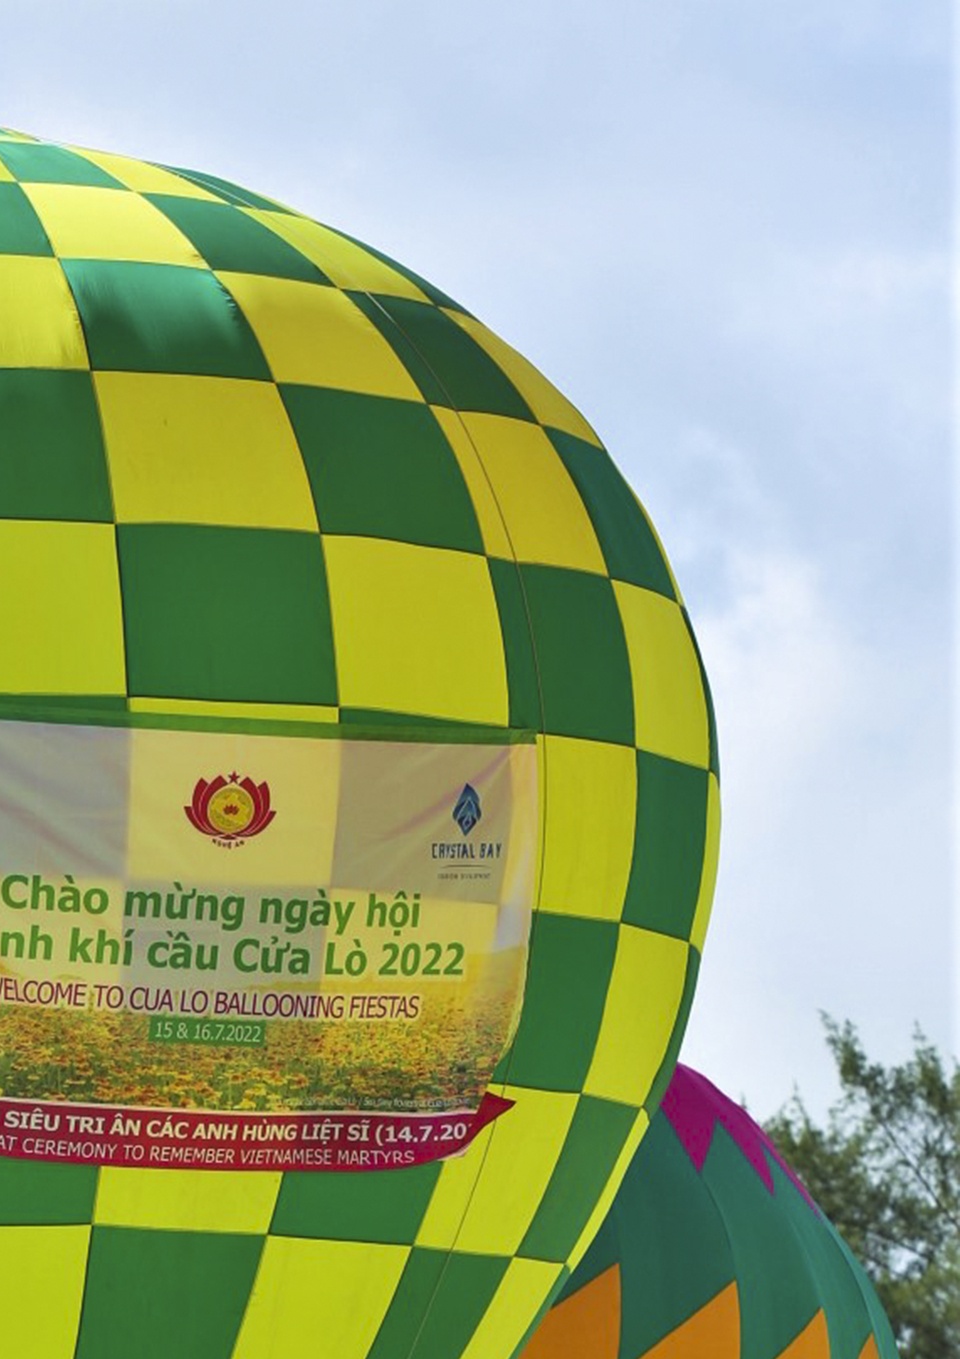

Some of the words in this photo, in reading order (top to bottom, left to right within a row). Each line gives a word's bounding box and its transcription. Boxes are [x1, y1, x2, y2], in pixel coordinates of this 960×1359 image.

[431, 842, 475, 860] CRYSTAL
[479, 842, 502, 860] BAY
[0, 874, 110, 915] Chào
[123, 881, 246, 932] mừng
[258, 888, 356, 936] ngày
[365, 890, 422, 937] hội
[68, 926, 136, 967] khí
[146, 931, 220, 971] cầu
[232, 936, 311, 975] Cửa
[324, 939, 368, 977] Lò
[377, 942, 466, 977] 2022
[93, 984, 124, 1009] TO
[128, 986, 174, 1012] CUA
[179, 989, 209, 1014] LO
[213, 991, 345, 1019] BALLOONING
[348, 994, 420, 1019] FIESTAS
[154, 1021, 174, 1039] 15
[176, 1022, 189, 1039] &
[193, 1023, 261, 1043] 16.7.2022
[3, 1108, 61, 1131] SIÊU
[65, 1114, 106, 1136] TRI
[109, 1112, 141, 1137] ÂN
[145, 1114, 190, 1140] CÁC
[192, 1122, 238, 1142] ANH
[242, 1118, 298, 1142] HÙNG
[300, 1118, 345, 1146] LIỆT
[347, 1118, 371, 1143] SĨ
[374, 1121, 473, 1147] (14.7.20
[21, 1137, 119, 1160] CEREMONY
[122, 1144, 146, 1161] TO
[149, 1146, 236, 1165] REMEMBER
[240, 1147, 333, 1166] VIETNAMESE
[336, 1149, 416, 1166] MARTYRS
